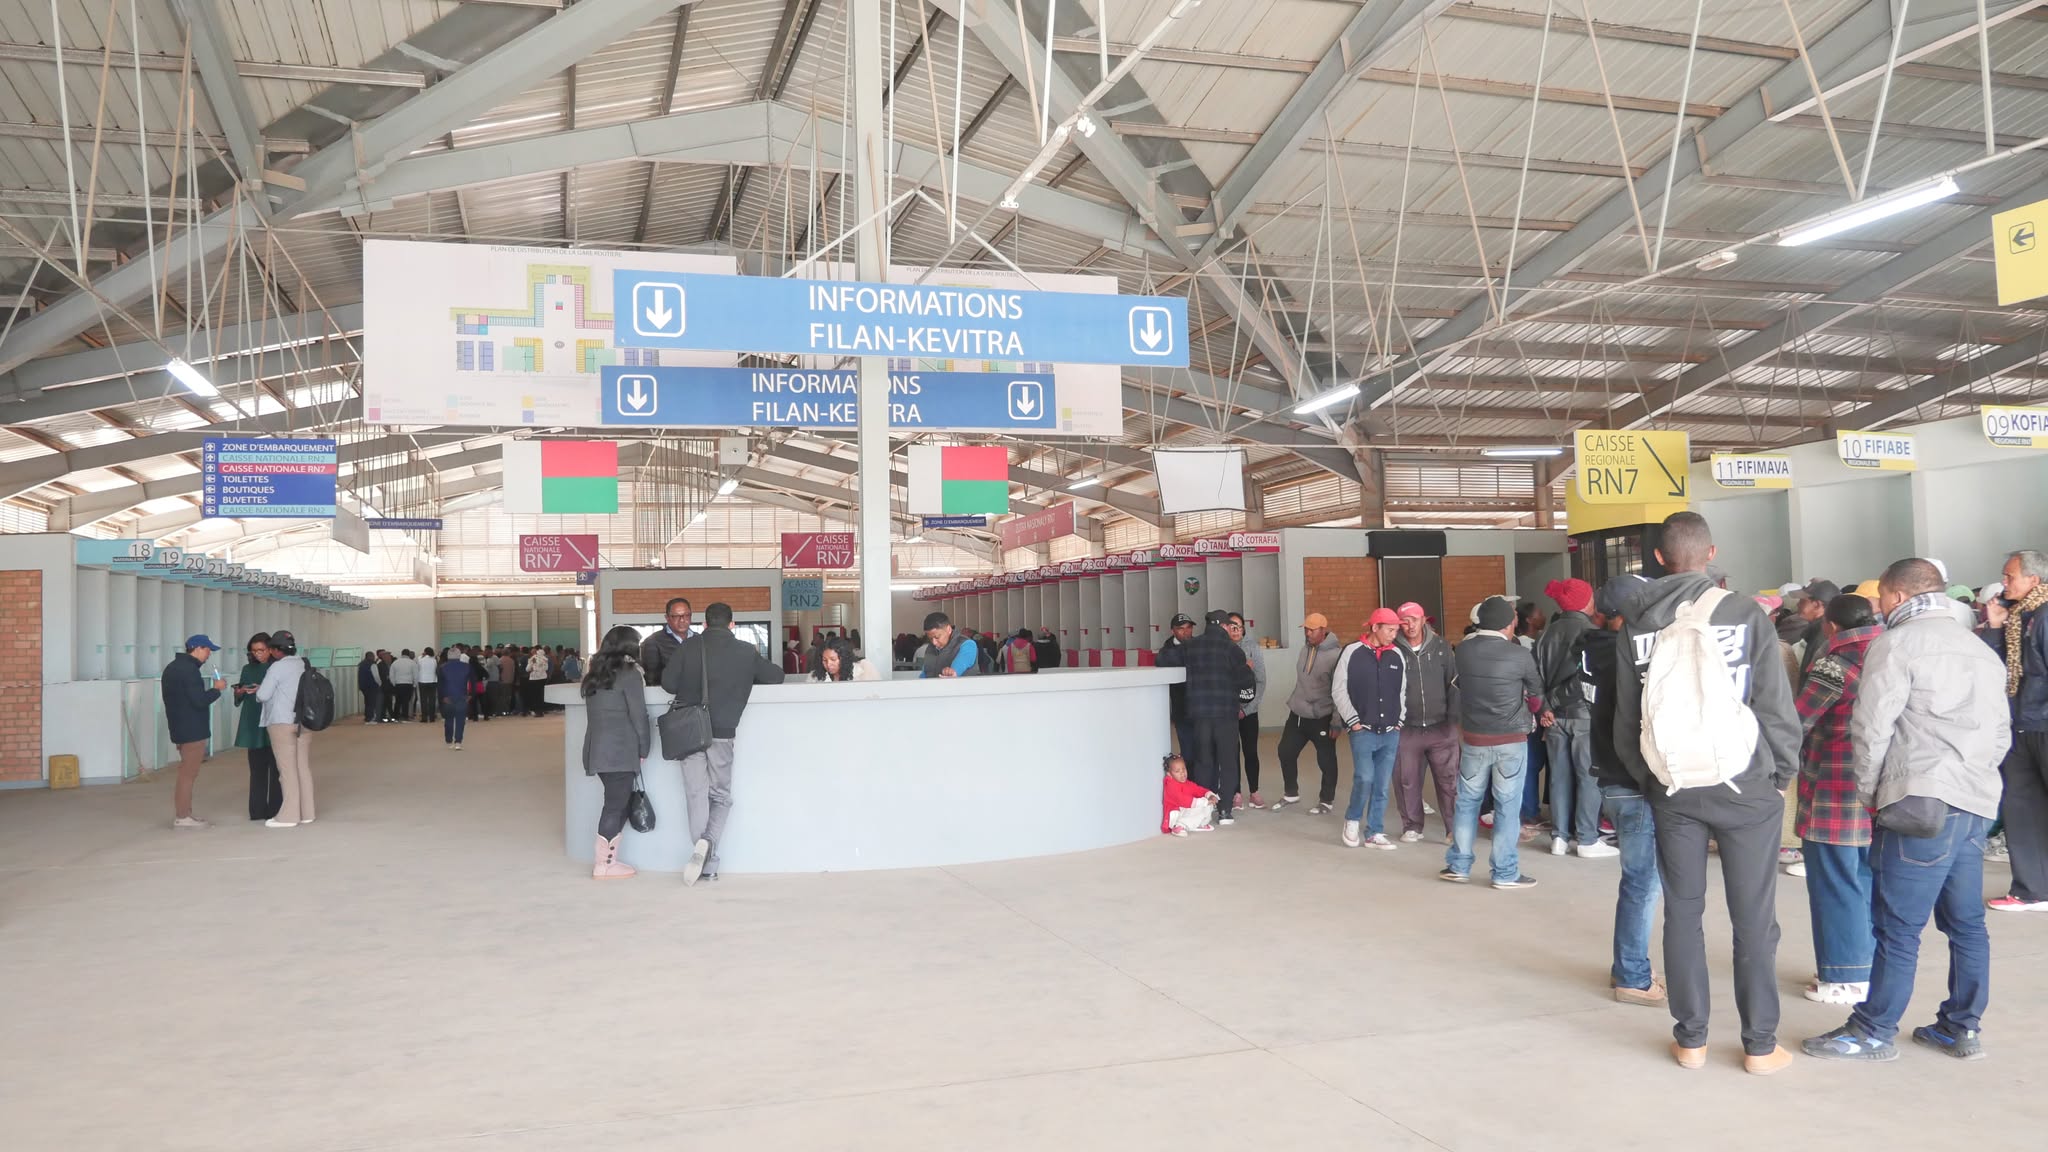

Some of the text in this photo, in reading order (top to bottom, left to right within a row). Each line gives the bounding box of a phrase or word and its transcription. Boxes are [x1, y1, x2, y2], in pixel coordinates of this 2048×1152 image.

[808, 284, 1024, 321] INFORMATIONS
[809, 322, 1025, 356] FILAN-KEVITRA
[752, 372, 922, 396] INFORMANS
[752, 401, 922, 424] FILAN-KERA
[1986, 414, 2009, 436] 09
[222, 443, 334, 452] ZONE D'EMBARQUEMENT
[1584, 434, 1636, 452] CAISSE
[1843, 438, 1911, 459] 10 FIFIABE
[222, 454, 326, 463] CAISSE NATIONALE RN2
[1584, 454, 1636, 466] REGIONALE
[222, 464, 326, 473] CAISSE NATIONALE RN7
[1716, 460, 1790, 479] 11 FIFIMAVA
[222, 475, 270, 484] TOILETTES
[1587, 468, 1639, 496] RN7
[222, 485, 275, 495] BOUTIQUES
[222, 496, 269, 504] BUVETTES
[222, 506, 326, 515] CAISSE NATIONALE RN2
[523, 536, 561, 547] CAISSE
[815, 534, 849, 544] CAISSE
[1231, 535, 1278, 547] 18 COTRAFIA
[131, 543, 151, 557] 18
[1163, 546, 1195, 558] 20 KOFI
[1197, 541, 1208, 553] 19
[162, 551, 179, 564] 19
[186, 557, 204, 570] 20
[525, 553, 563, 569] RN7
[816, 551, 851, 566] RN7
[1108, 557, 1119, 567] 22
[1133, 553, 1145, 562] 21
[207, 562, 224, 574] 21
[227, 566, 243, 577] 22
[1061, 565, 1072, 573] 24
[1084, 561, 1095, 570] 23
[247, 572, 259, 583] 23
[262, 575, 275, 586] 24
[289, 581, 302, 591] 26
[788, 580, 819, 589] CAISSE
[790, 594, 820, 607] RN2
